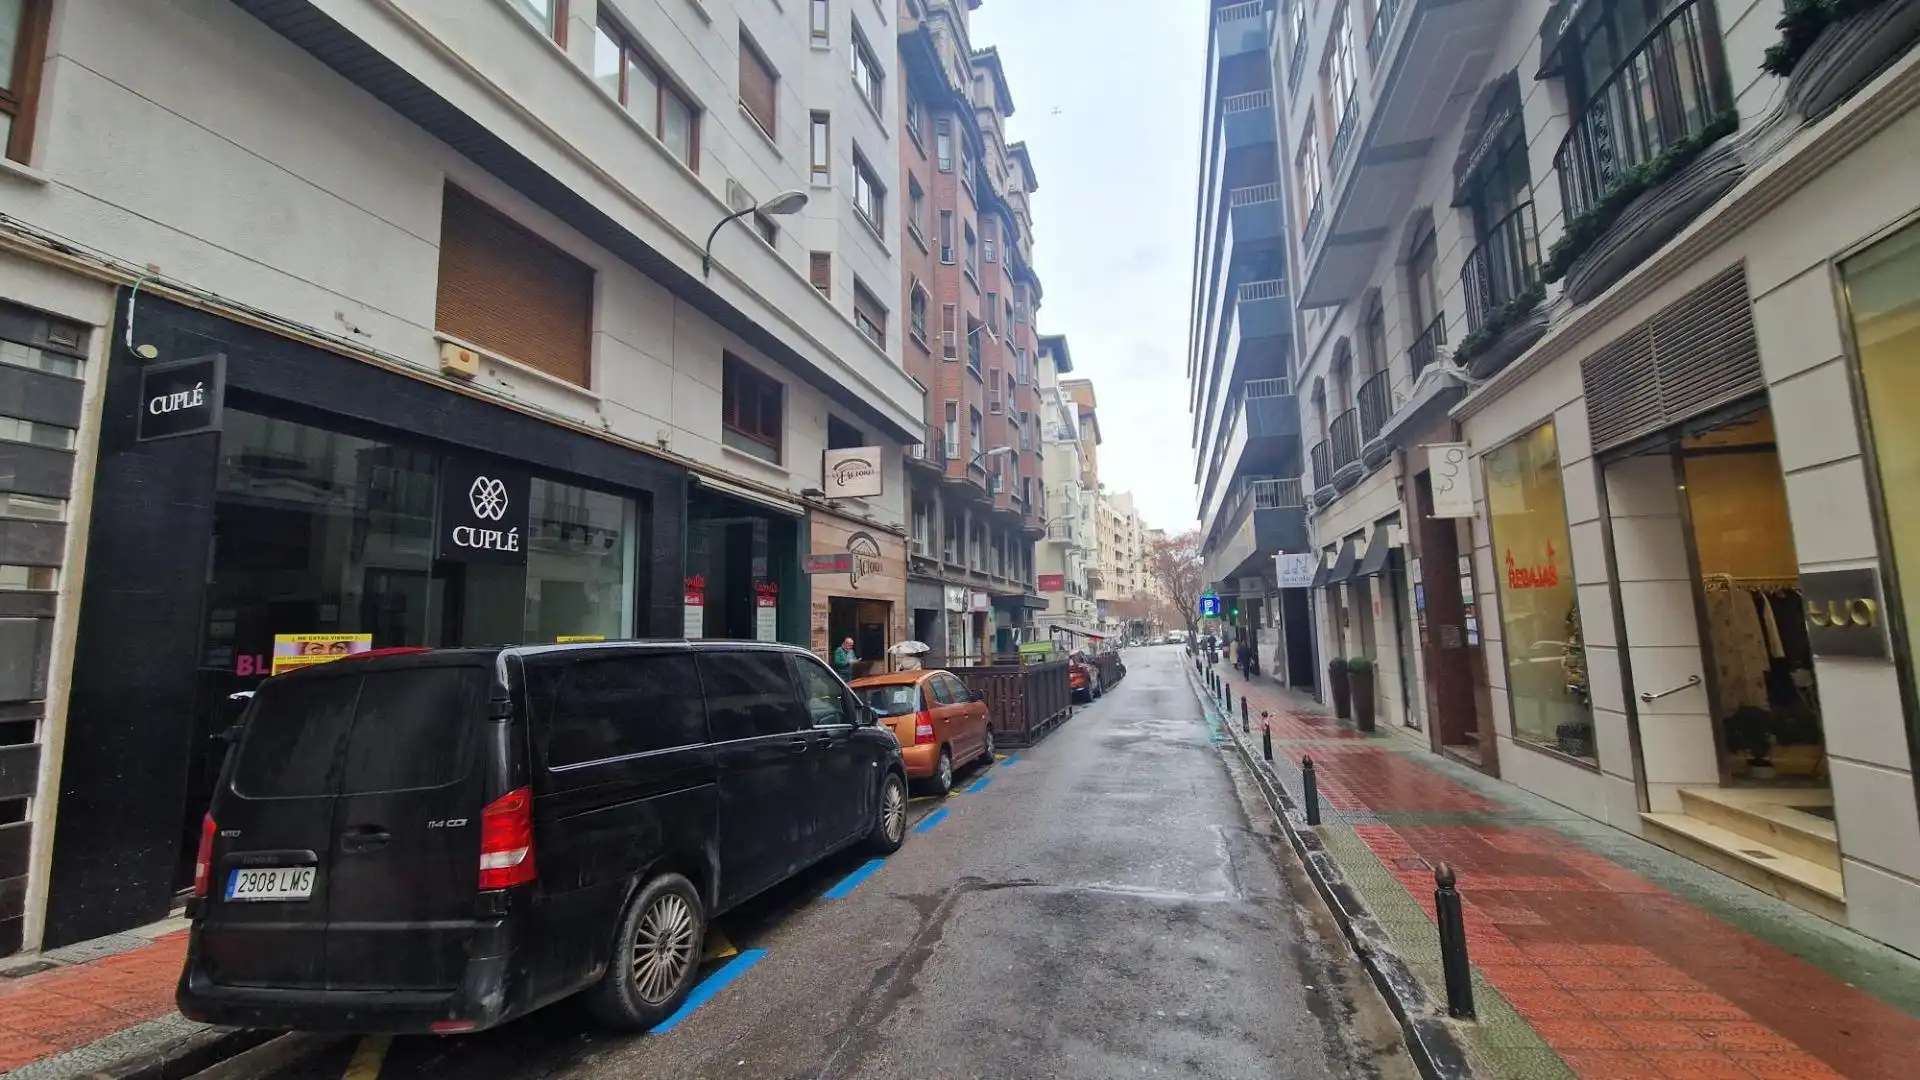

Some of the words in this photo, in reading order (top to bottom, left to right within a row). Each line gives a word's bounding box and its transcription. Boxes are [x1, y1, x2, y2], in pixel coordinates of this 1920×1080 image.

[149, 381, 203, 415] CUPLÉ
[452, 526, 519, 552] CUPLÉ
[1204, 599, 1214, 611] P
[238, 872, 277, 893] 2908
[280, 870, 311, 892] LMS
